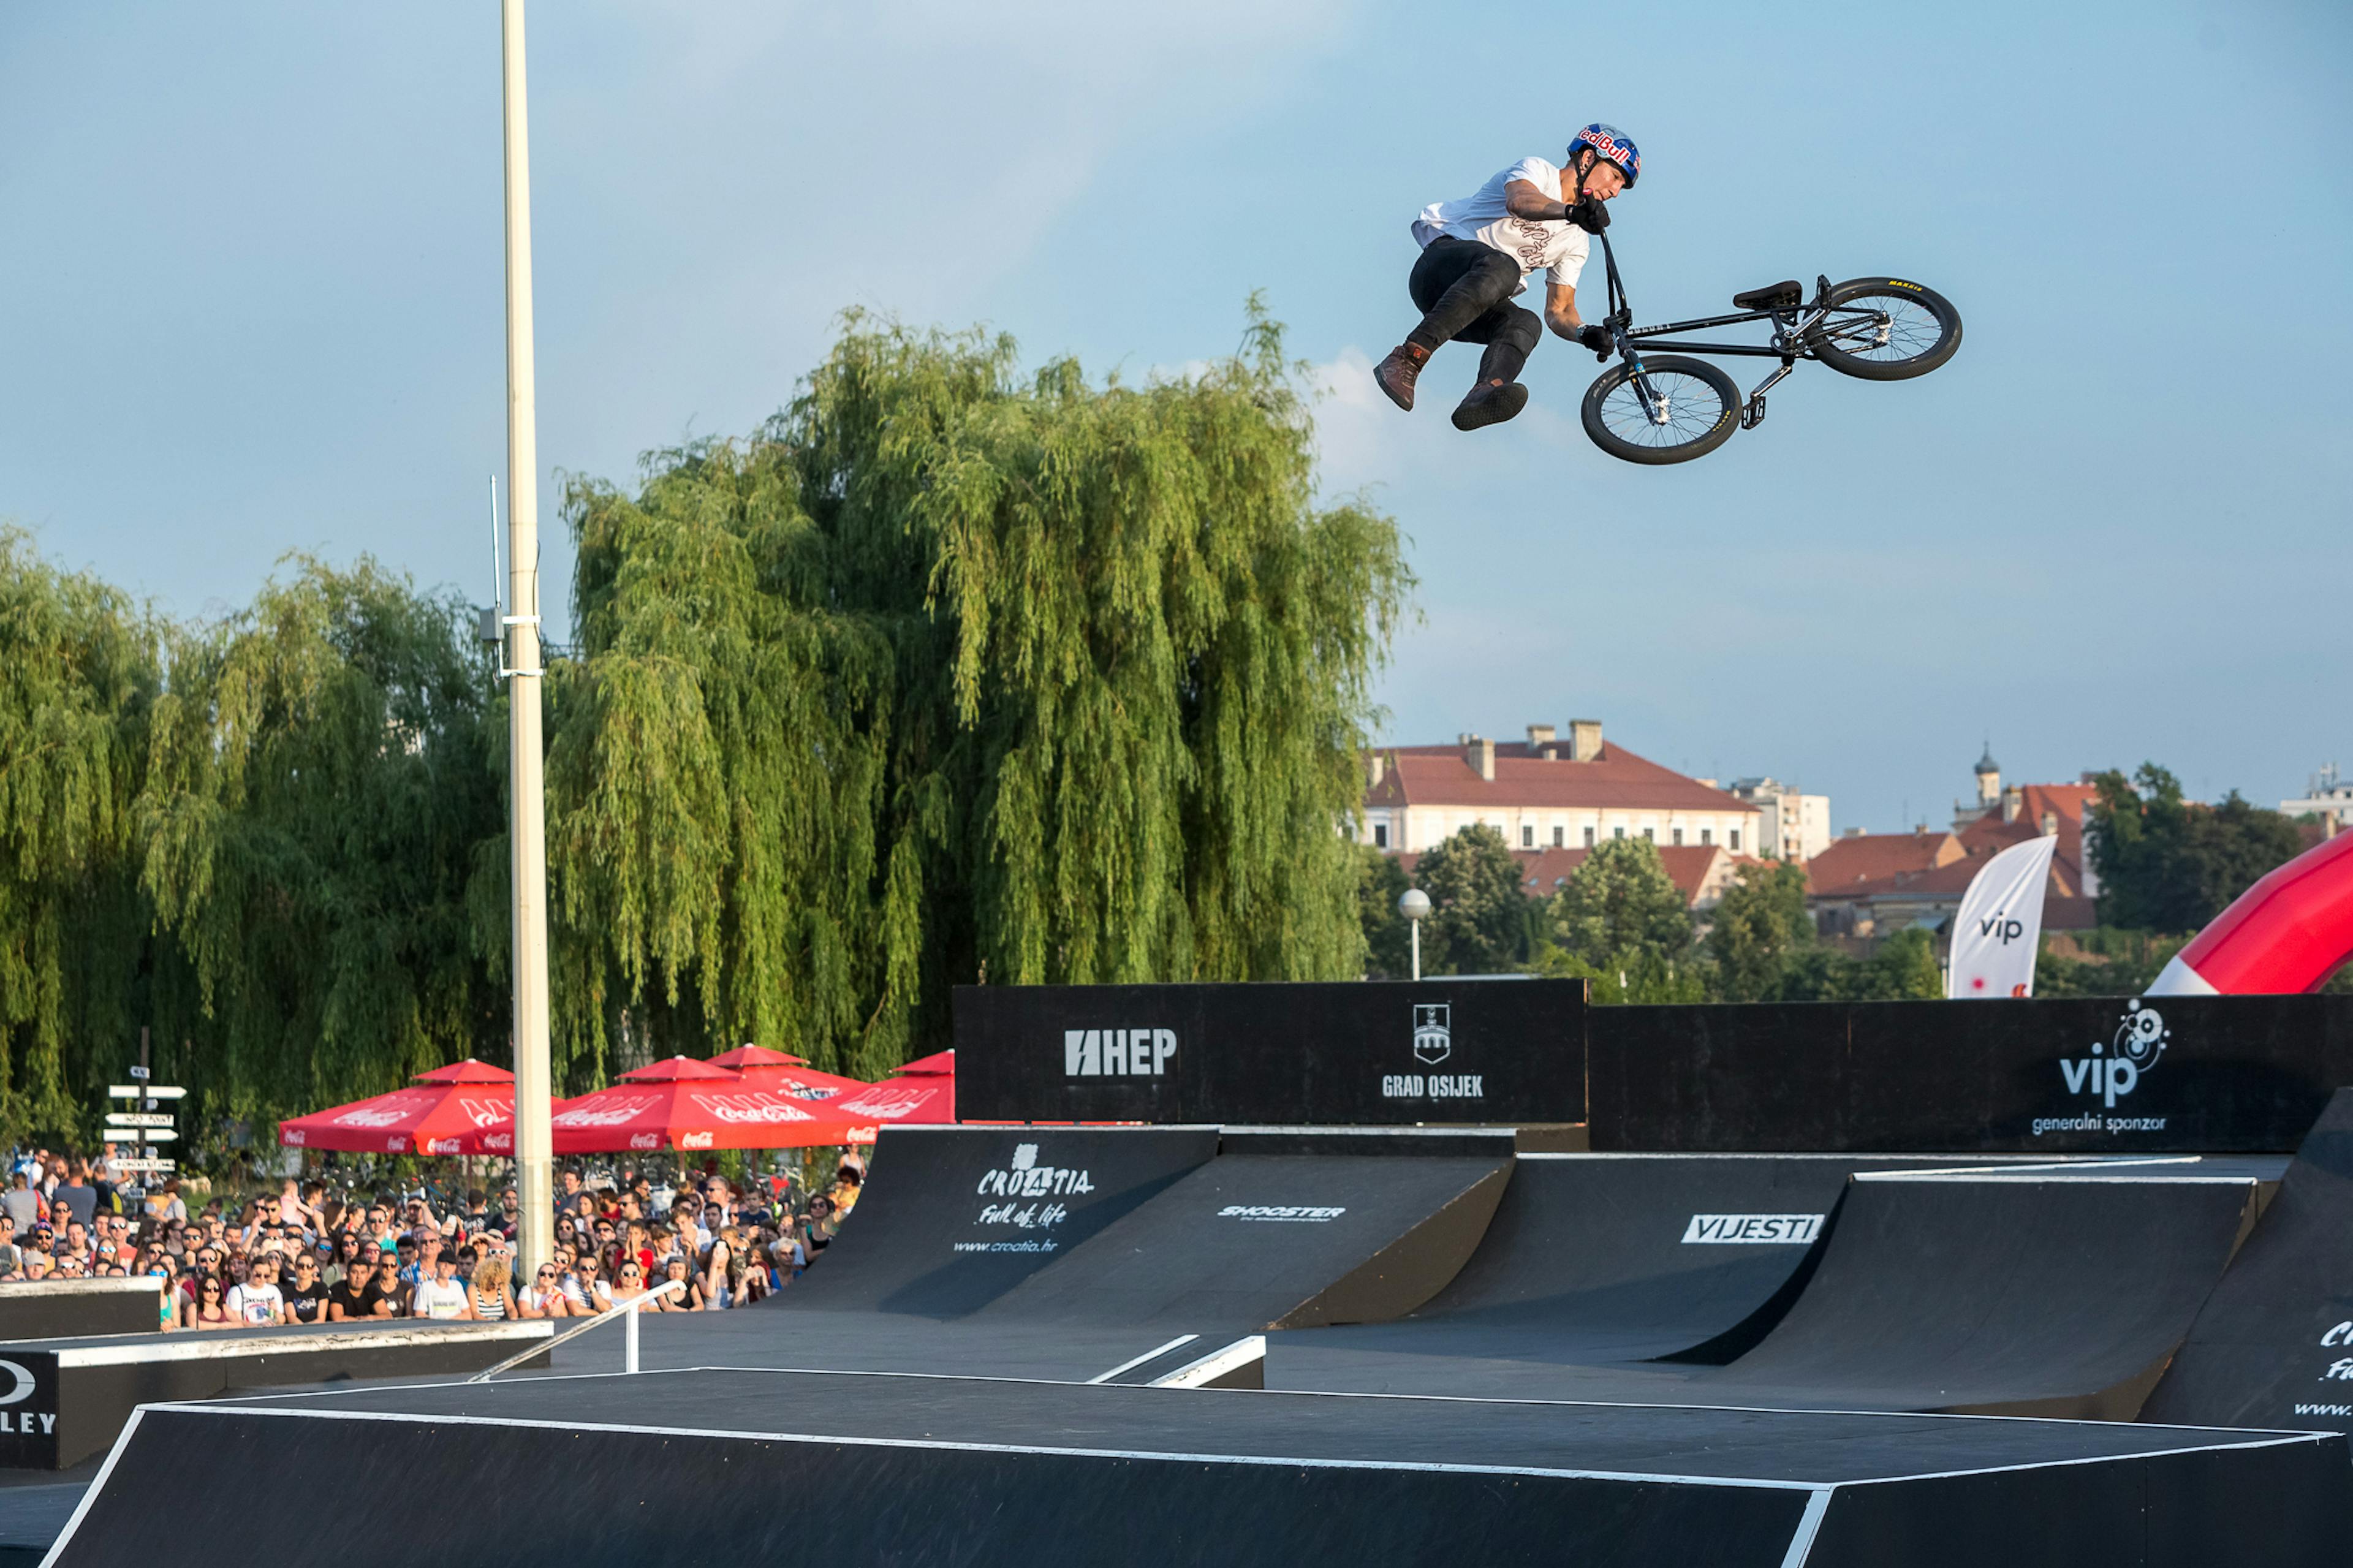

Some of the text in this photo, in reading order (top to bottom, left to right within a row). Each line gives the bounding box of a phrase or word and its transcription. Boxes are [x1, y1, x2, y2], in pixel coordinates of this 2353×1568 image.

[1596, 134, 1631, 165] Bull
[1980, 911, 2022, 945] vip
[1102, 1028, 1177, 1075] HEP
[1382, 1075, 1483, 1097] GRAD OSIJEK
[2059, 1042, 2138, 1108] vip
[2032, 1112, 2166, 1135] generalni sponzor
[977, 1167, 1095, 1196] CROATIA
[979, 1202, 1067, 1229] Full of life
[1218, 1205, 1346, 1218] SHOOSTER
[1698, 1219, 1814, 1238] VIJESTI
[953, 1238, 1058, 1252] www.croatia.hr
